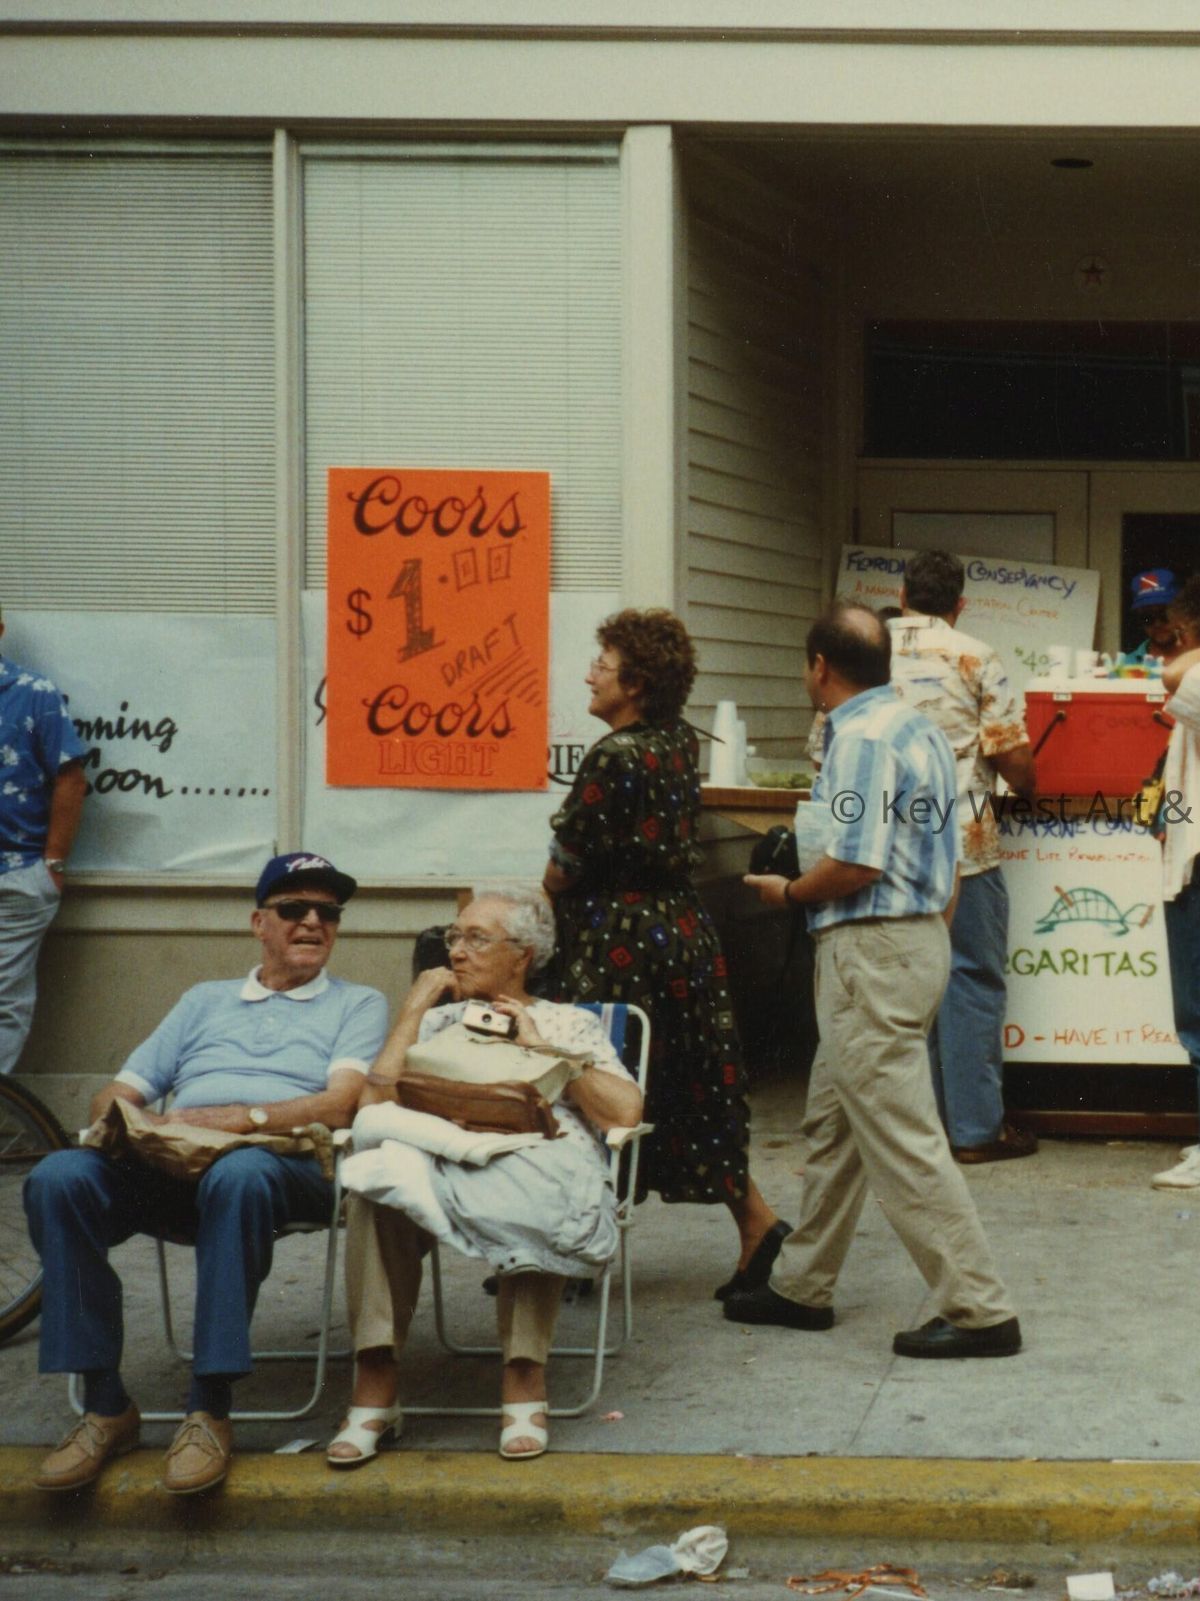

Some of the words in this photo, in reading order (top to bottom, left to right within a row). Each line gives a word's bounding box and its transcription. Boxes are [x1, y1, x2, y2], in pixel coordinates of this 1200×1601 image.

[347, 475, 527, 539] Coors
[440, 613, 525, 688] DRAFT
[362, 684, 516, 738] Coors
[378, 739, 500, 778] LIGHT
[1054, 1028, 1107, 1046] HAVE
[1115, 1029, 1136, 1043] IT
